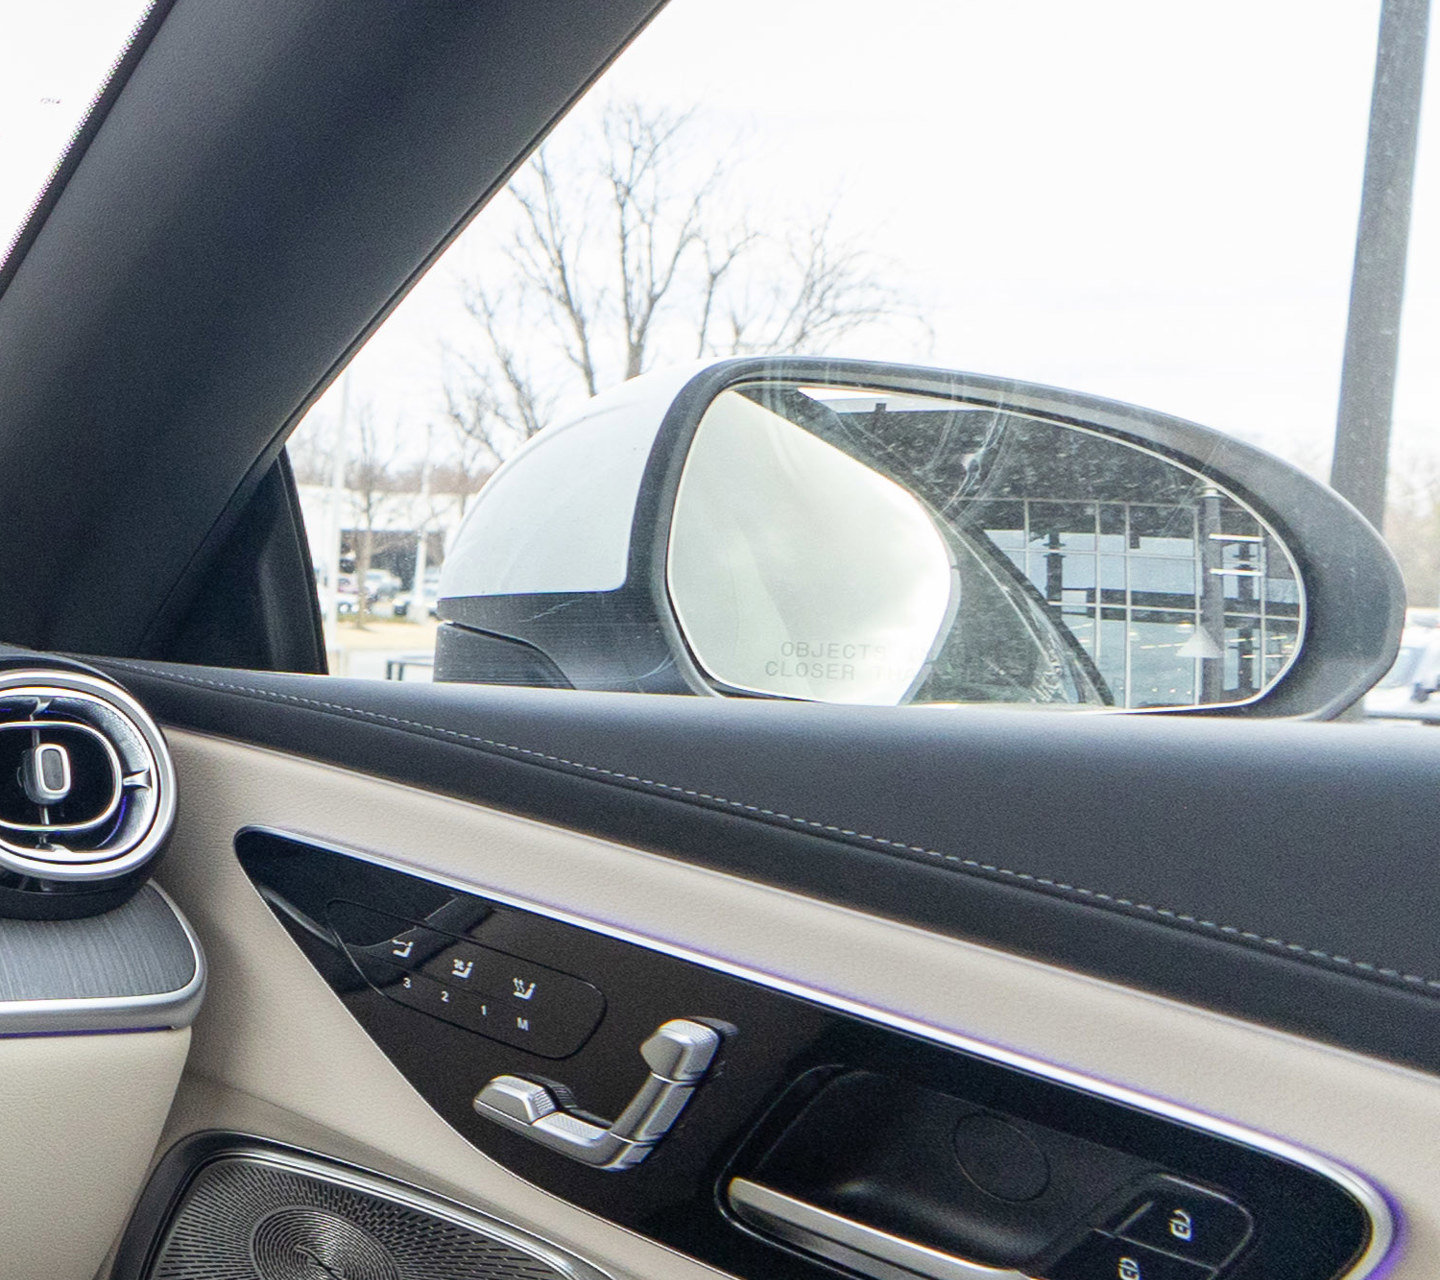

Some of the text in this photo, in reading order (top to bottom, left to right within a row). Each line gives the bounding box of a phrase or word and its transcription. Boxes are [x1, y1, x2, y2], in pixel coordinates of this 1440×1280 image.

[764, 661, 856, 681] CLOSER
[402, 976, 412, 989] 3
[440, 990, 450, 1003] 2
[480, 1004, 487, 1016] 1
[516, 1016, 529, 1031] M
